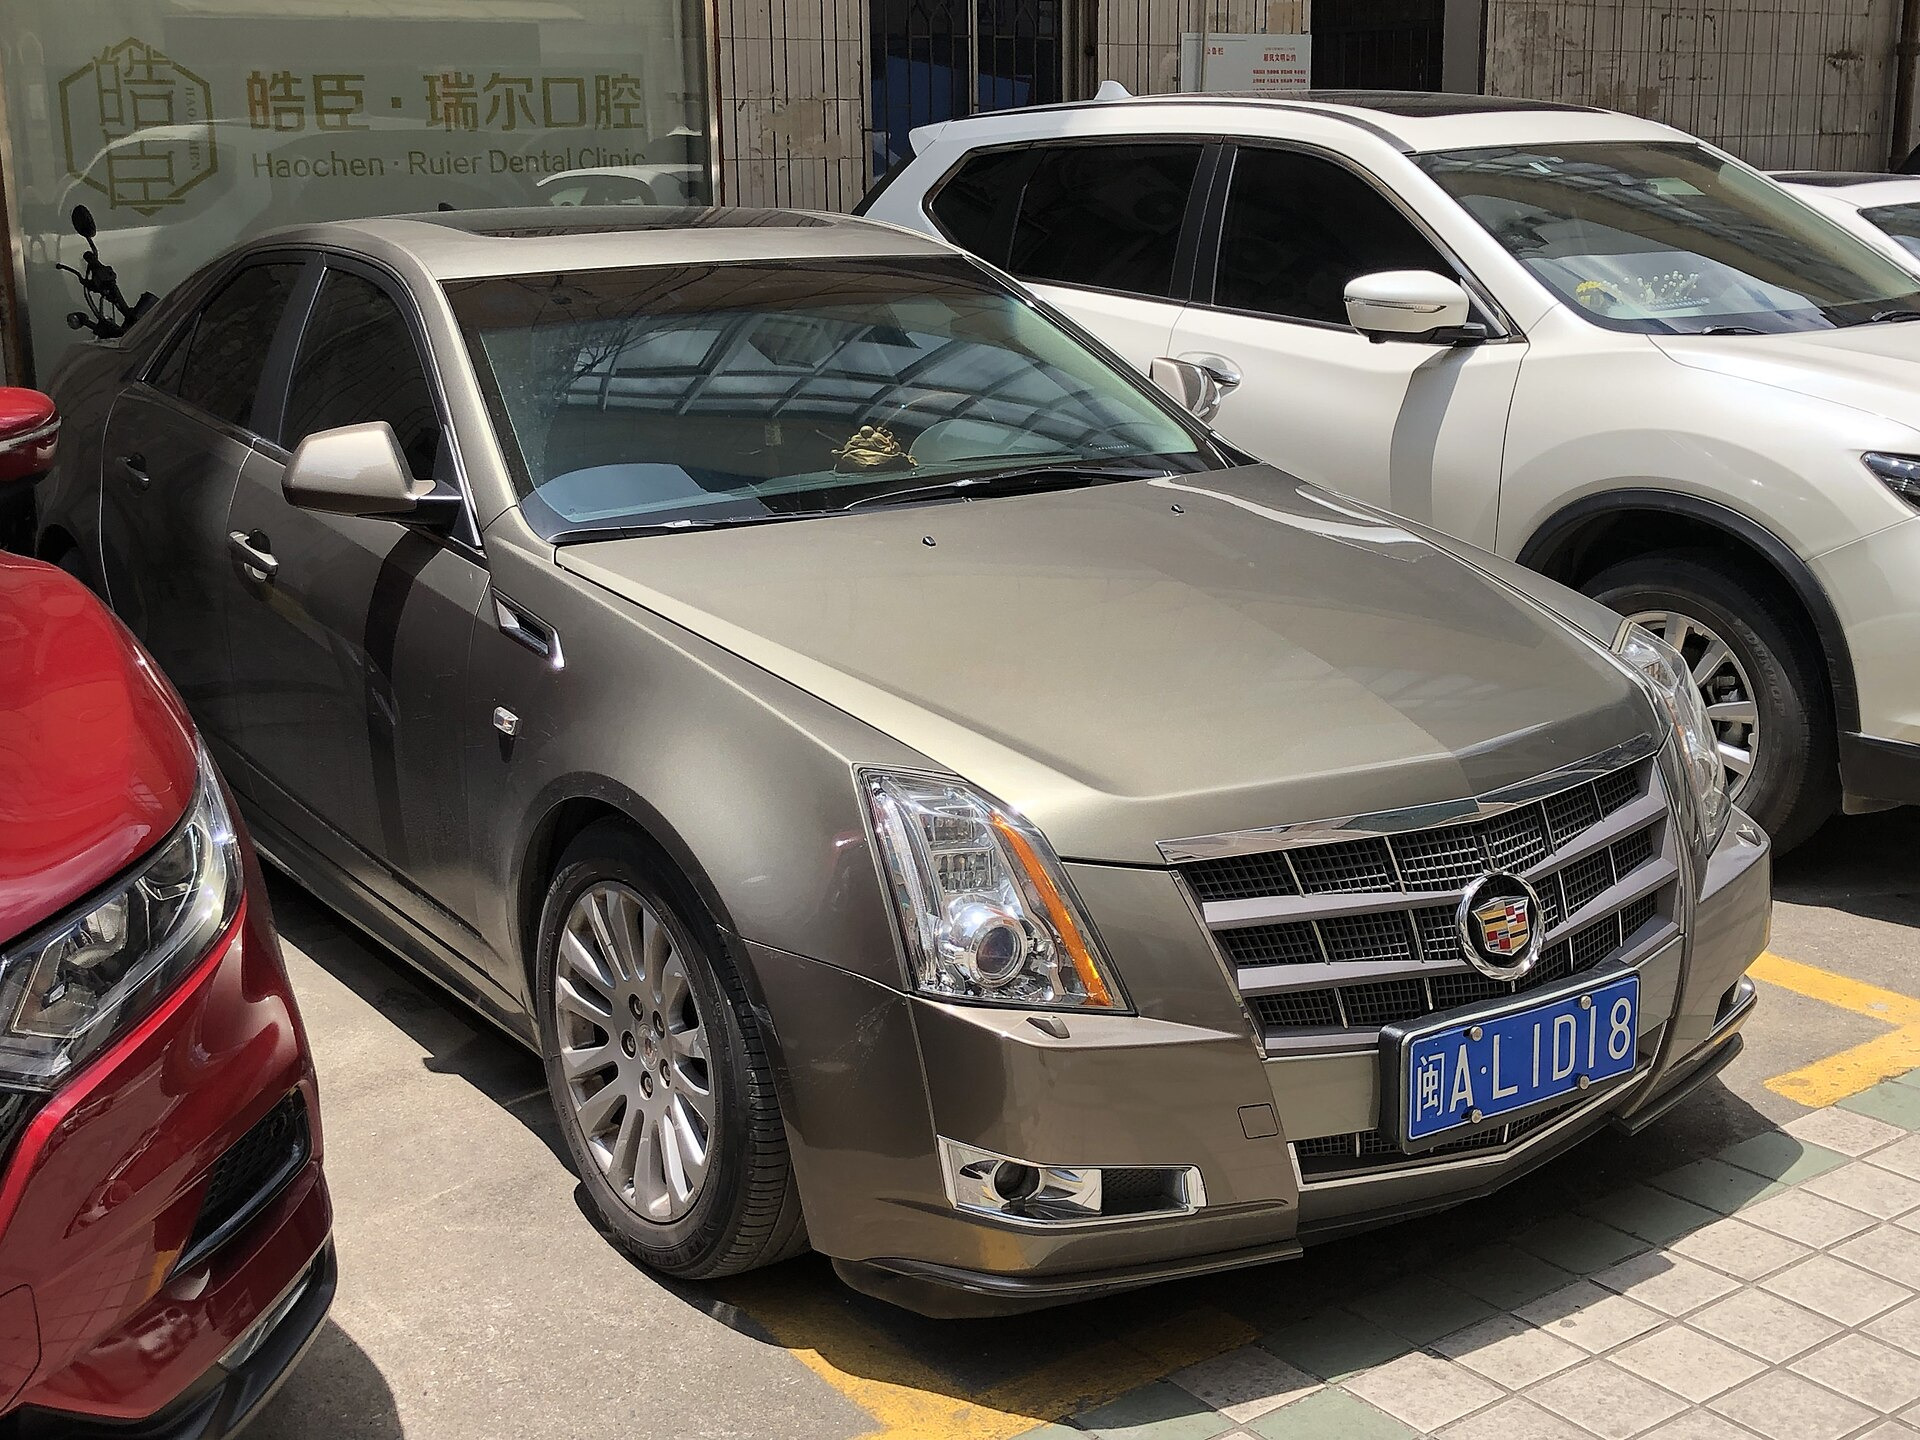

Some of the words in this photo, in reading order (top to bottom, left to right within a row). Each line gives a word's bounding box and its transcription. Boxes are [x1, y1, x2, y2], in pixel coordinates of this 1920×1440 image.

[252, 150, 385, 179] Haochen
[407, 148, 483, 176] Ruier
[489, 147, 572, 174] Dental
[578, 147, 646, 170] Clinic
